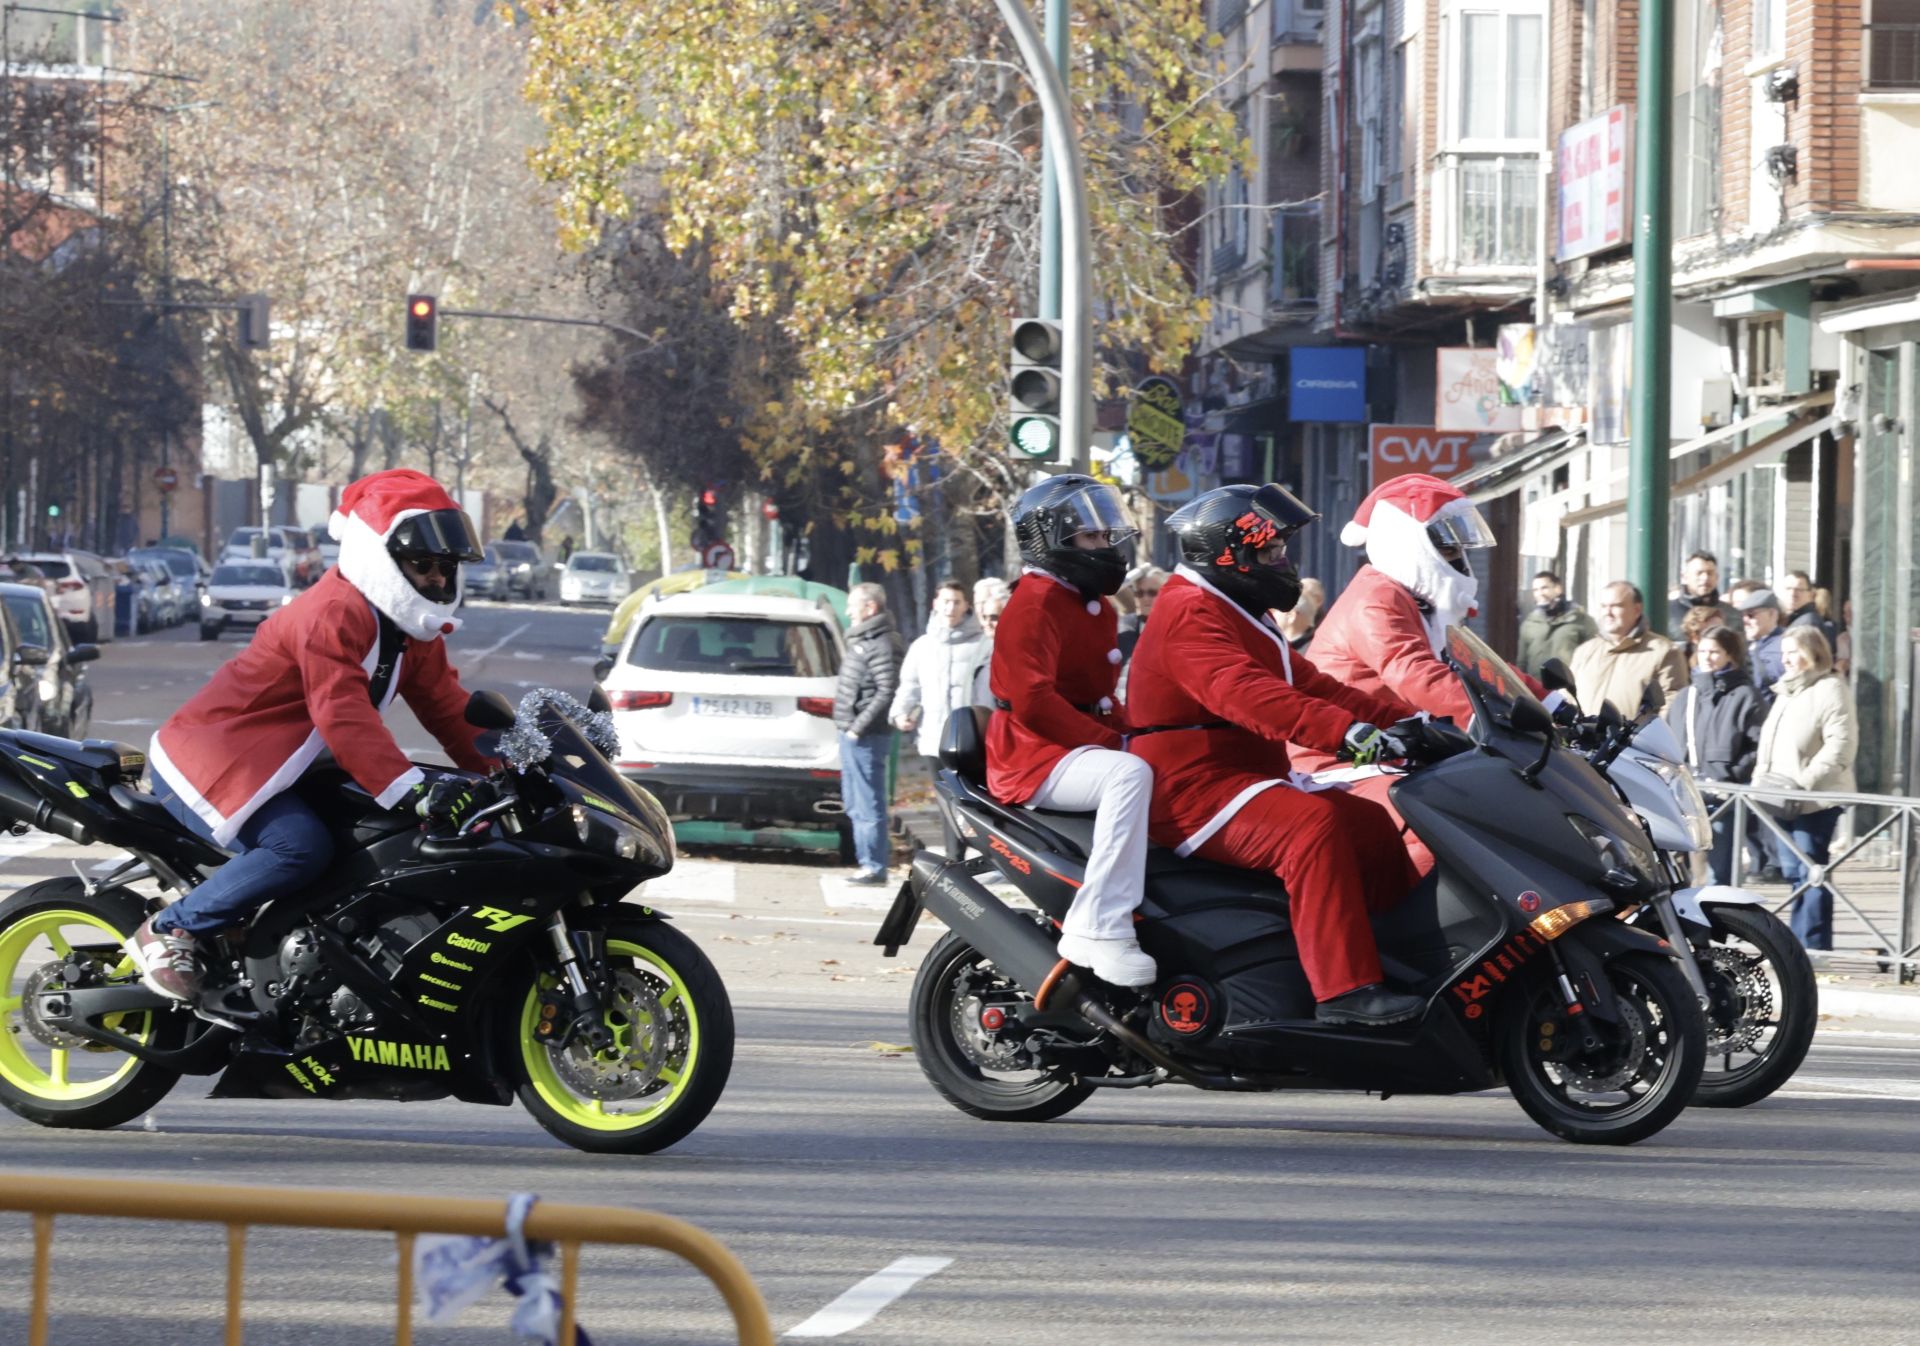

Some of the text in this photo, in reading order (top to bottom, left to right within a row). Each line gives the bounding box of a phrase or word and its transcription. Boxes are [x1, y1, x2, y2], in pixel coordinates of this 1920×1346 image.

[1379, 436, 1469, 473] CWT
[446, 932, 492, 954] Castrol
[439, 955, 473, 972] brembo
[419, 973, 462, 991] MICHELIN
[346, 1035, 450, 1071] YAMAHA
[301, 1055, 336, 1086] NGK
